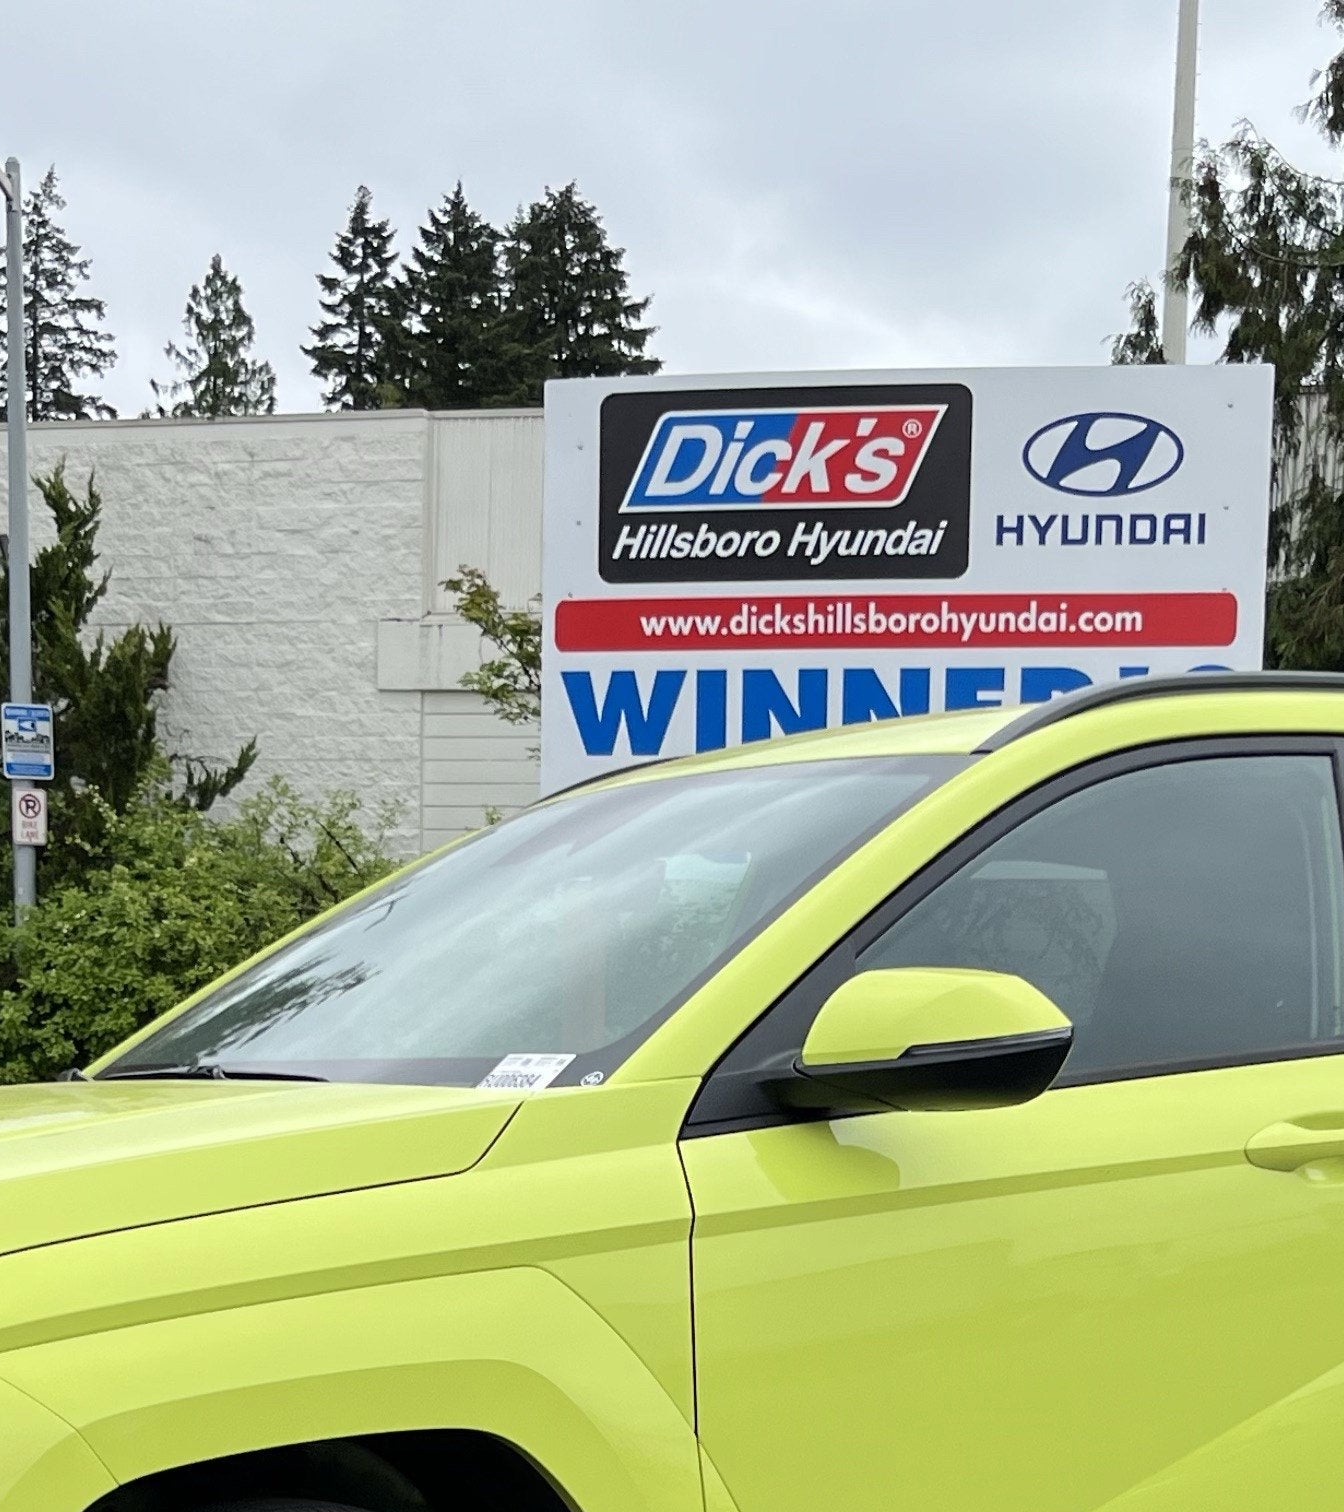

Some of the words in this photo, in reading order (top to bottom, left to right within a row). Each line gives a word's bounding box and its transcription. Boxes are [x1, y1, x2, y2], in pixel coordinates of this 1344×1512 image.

[612, 522, 781, 560] Hillsboro
[786, 520, 949, 565] Hyundai
[995, 512, 1206, 547] HYUNDAI
[639, 603, 1143, 642] www.dickshillsborohyundai.com
